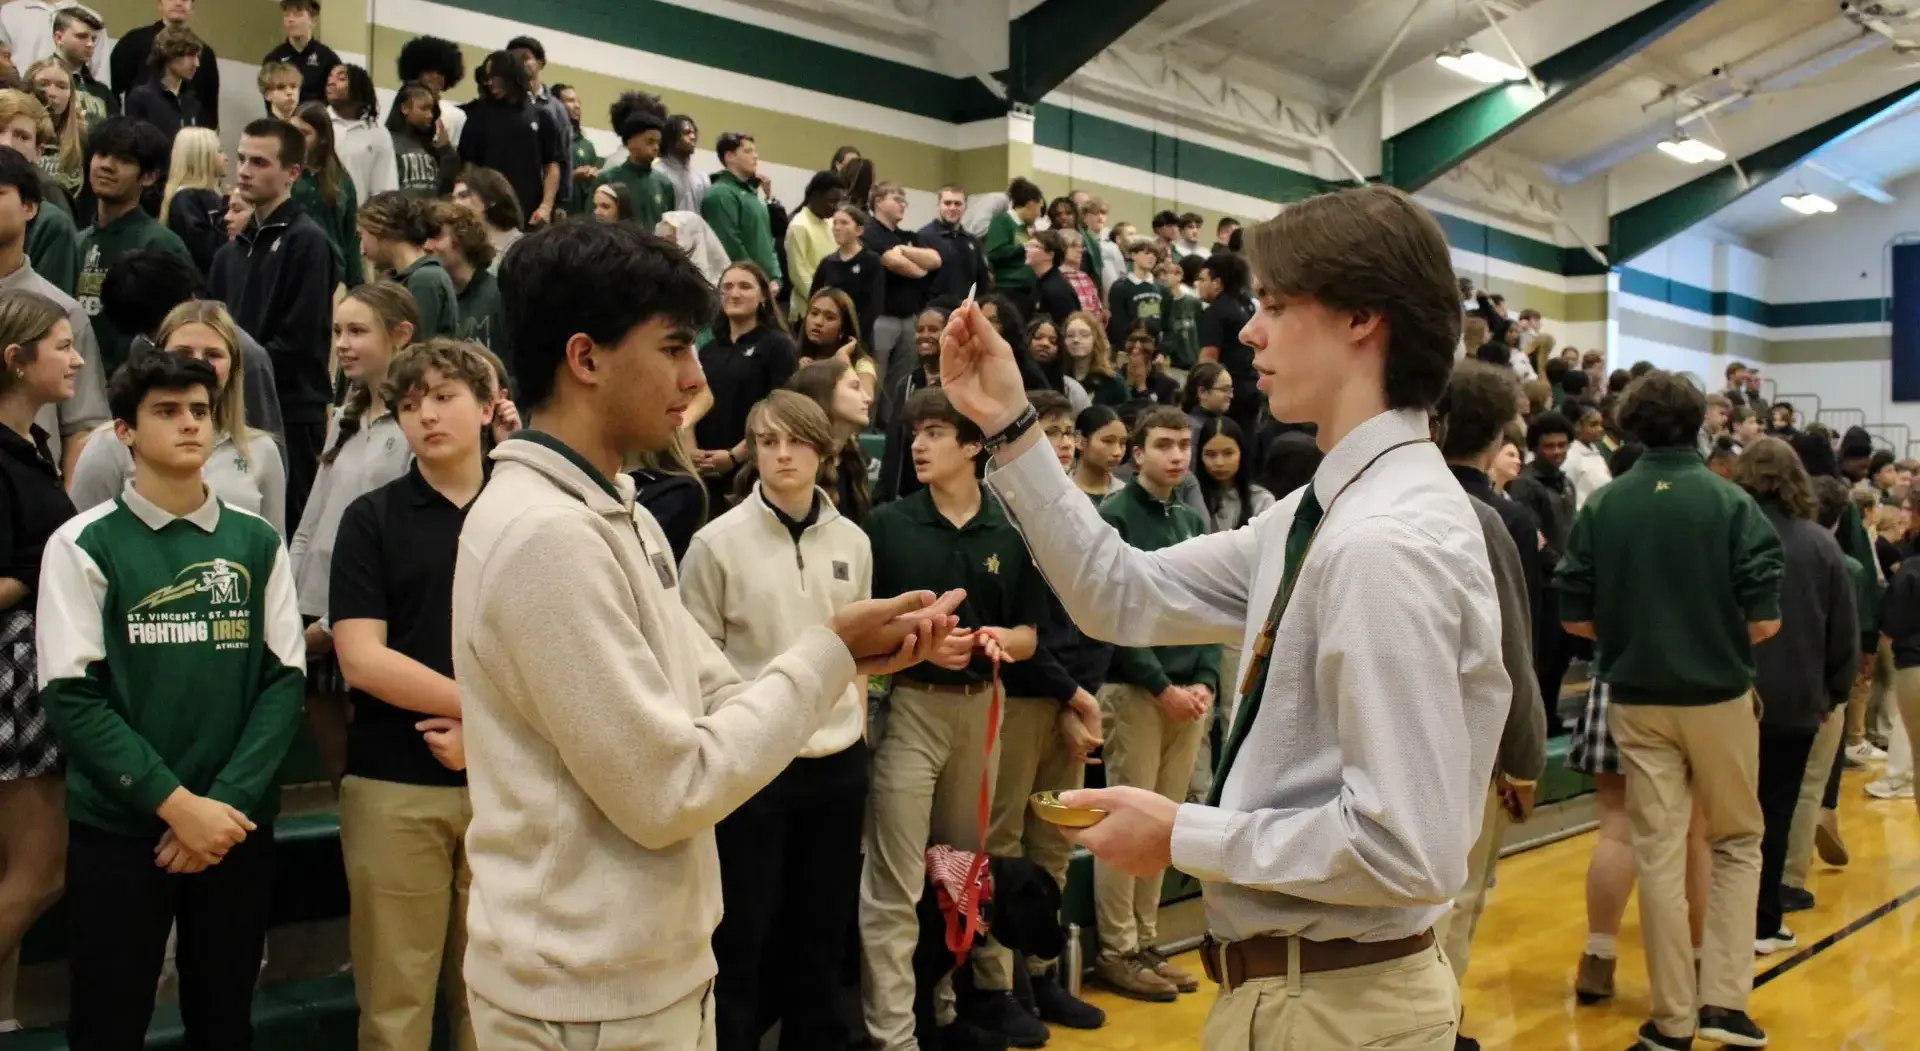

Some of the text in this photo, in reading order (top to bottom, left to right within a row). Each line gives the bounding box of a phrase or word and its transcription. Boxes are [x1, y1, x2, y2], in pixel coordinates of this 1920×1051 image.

[401, 152, 438, 183] IRIS
[127, 613, 145, 621] ST.
[148, 611, 197, 621] VINCENT
[208, 610, 225, 620] ST.
[127, 620, 208, 644] FIGHTING
